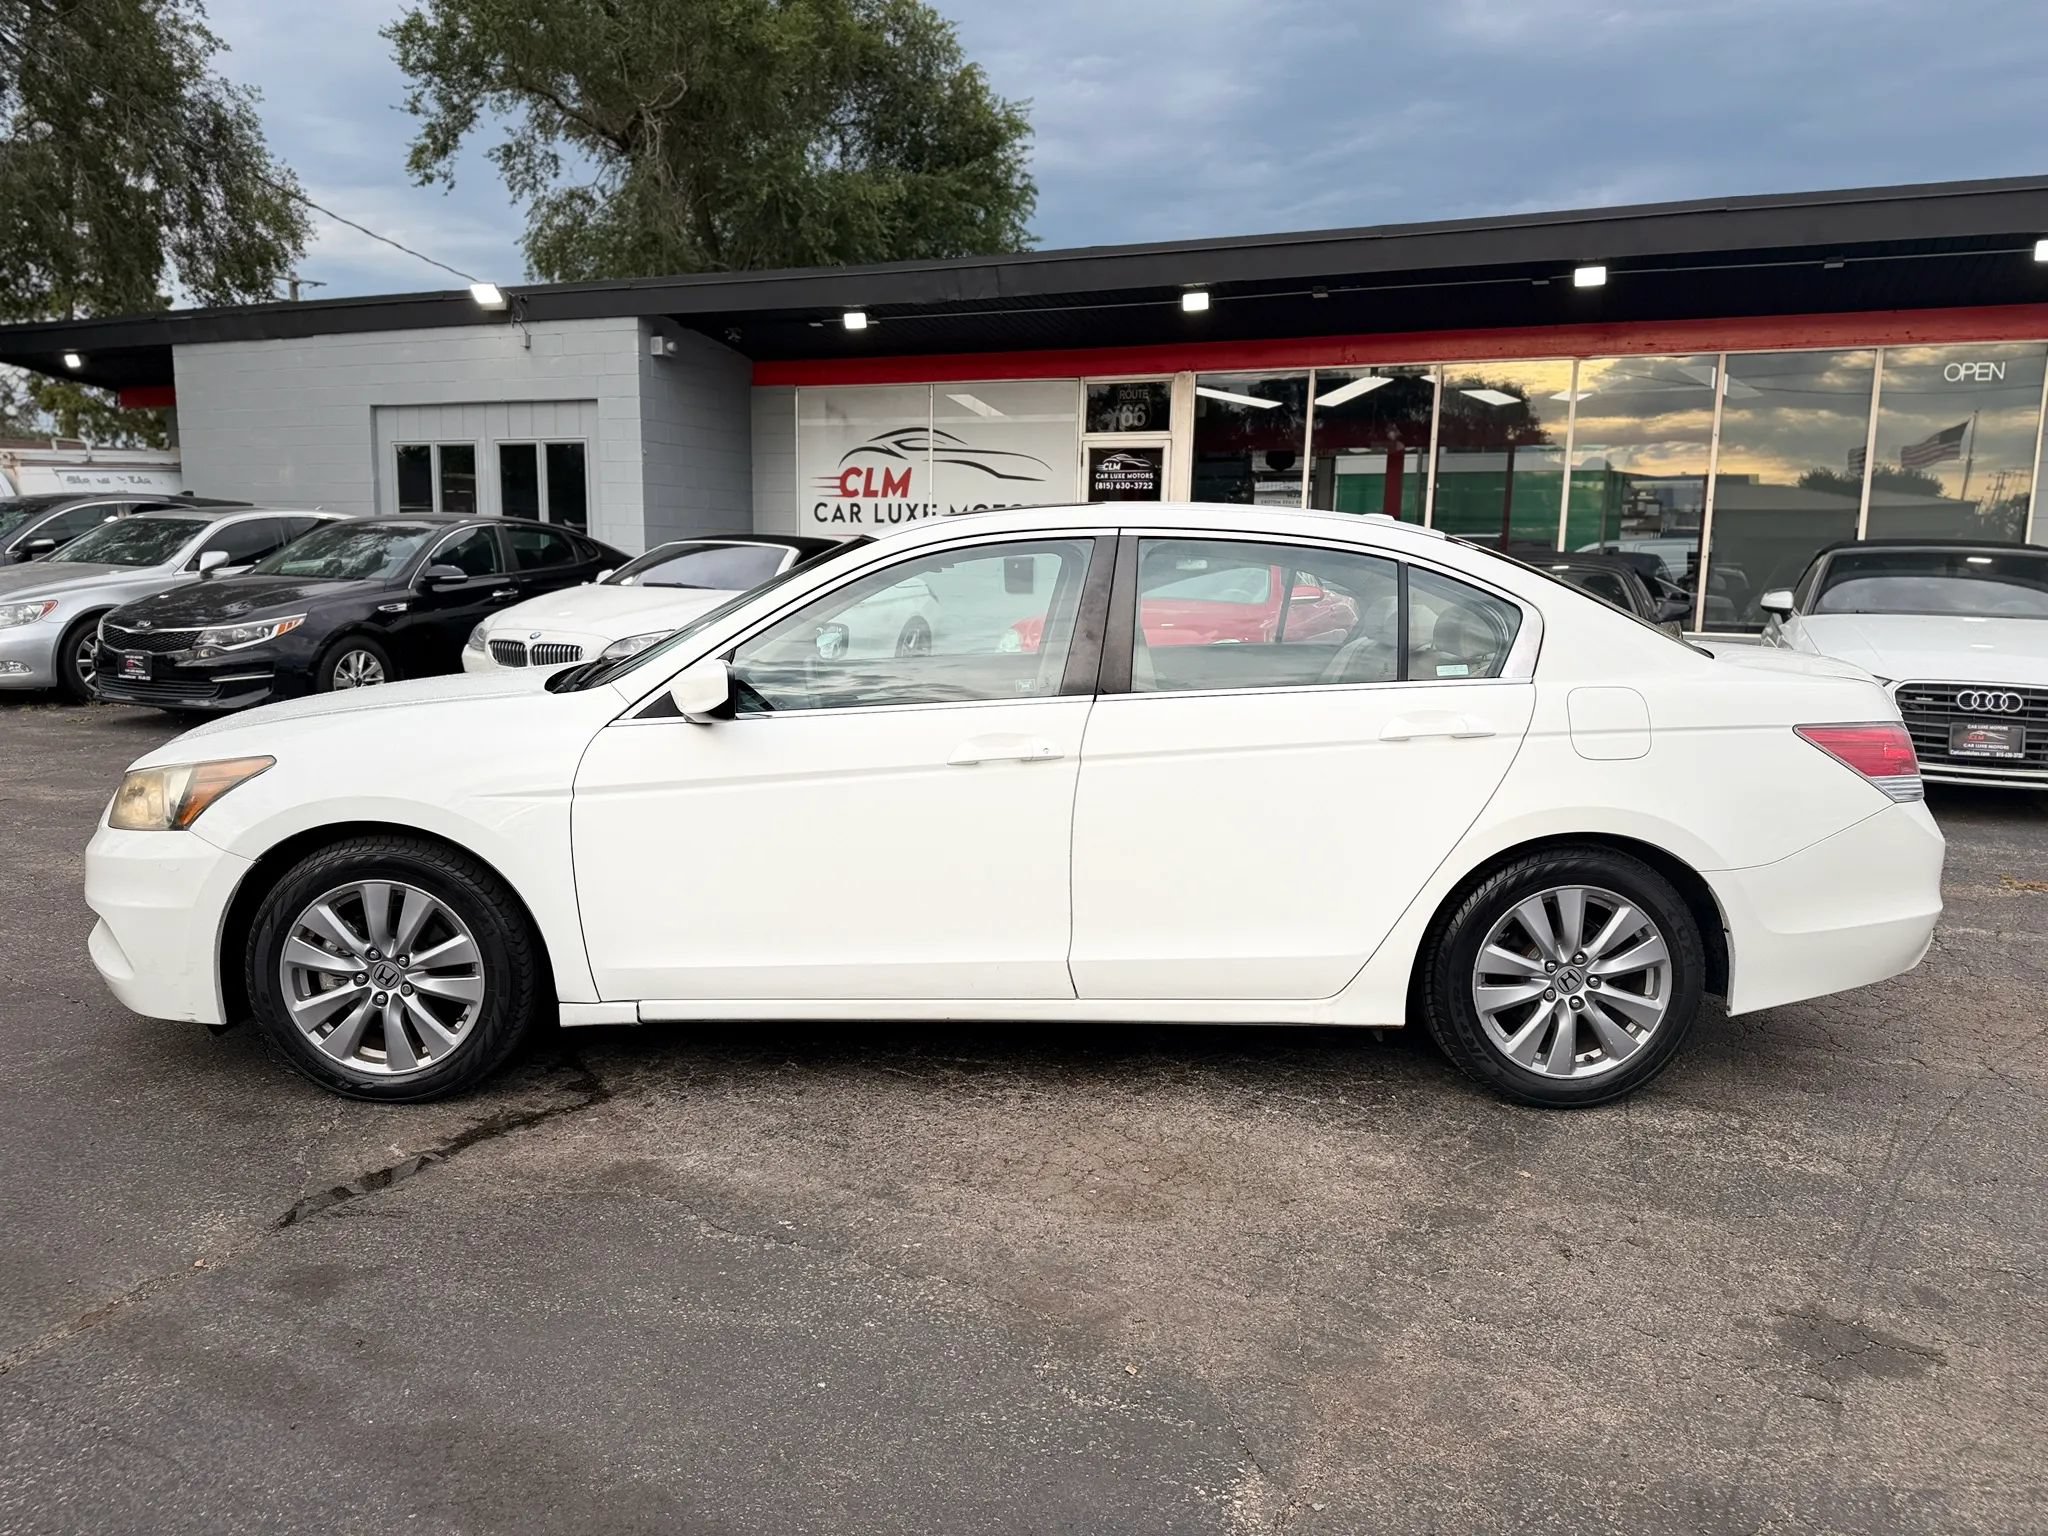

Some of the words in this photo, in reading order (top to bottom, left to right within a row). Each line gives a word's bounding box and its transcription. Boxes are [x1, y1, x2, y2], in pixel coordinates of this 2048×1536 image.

[1944, 361, 2006, 382] OPEN
[1120, 388, 1149, 400] ROUTE
[1121, 403, 1146, 427] 66
[1103, 462, 1121, 470] CLM
[839, 466, 913, 498] CLM
[1095, 481, 1114, 490] (815)
[814, 502, 862, 524] CAR
